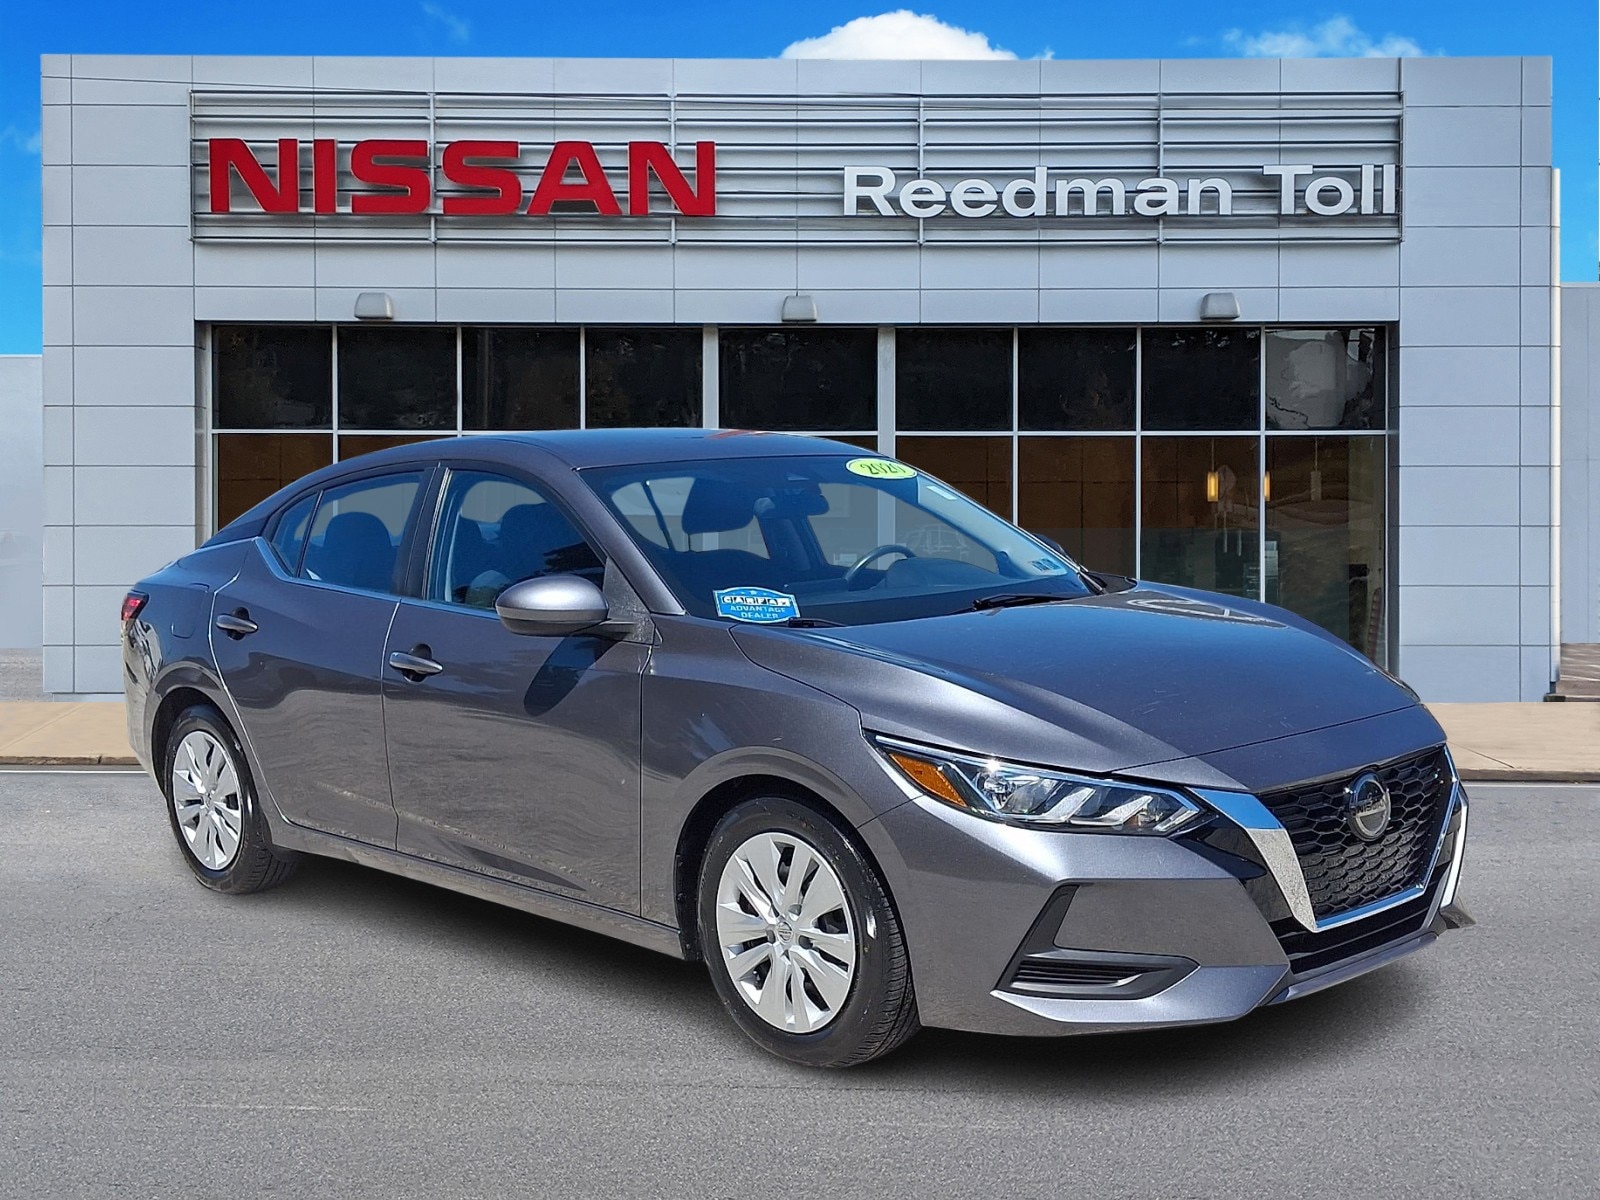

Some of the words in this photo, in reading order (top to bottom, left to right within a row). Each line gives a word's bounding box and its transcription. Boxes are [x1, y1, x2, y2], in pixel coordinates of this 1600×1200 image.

[209, 138, 716, 216] NISSAN
[842, 165, 1233, 219] Reedman
[1262, 163, 1398, 217] Toll
[730, 605, 787, 613] ADVANTAGE
[740, 611, 779, 619] DEALER
